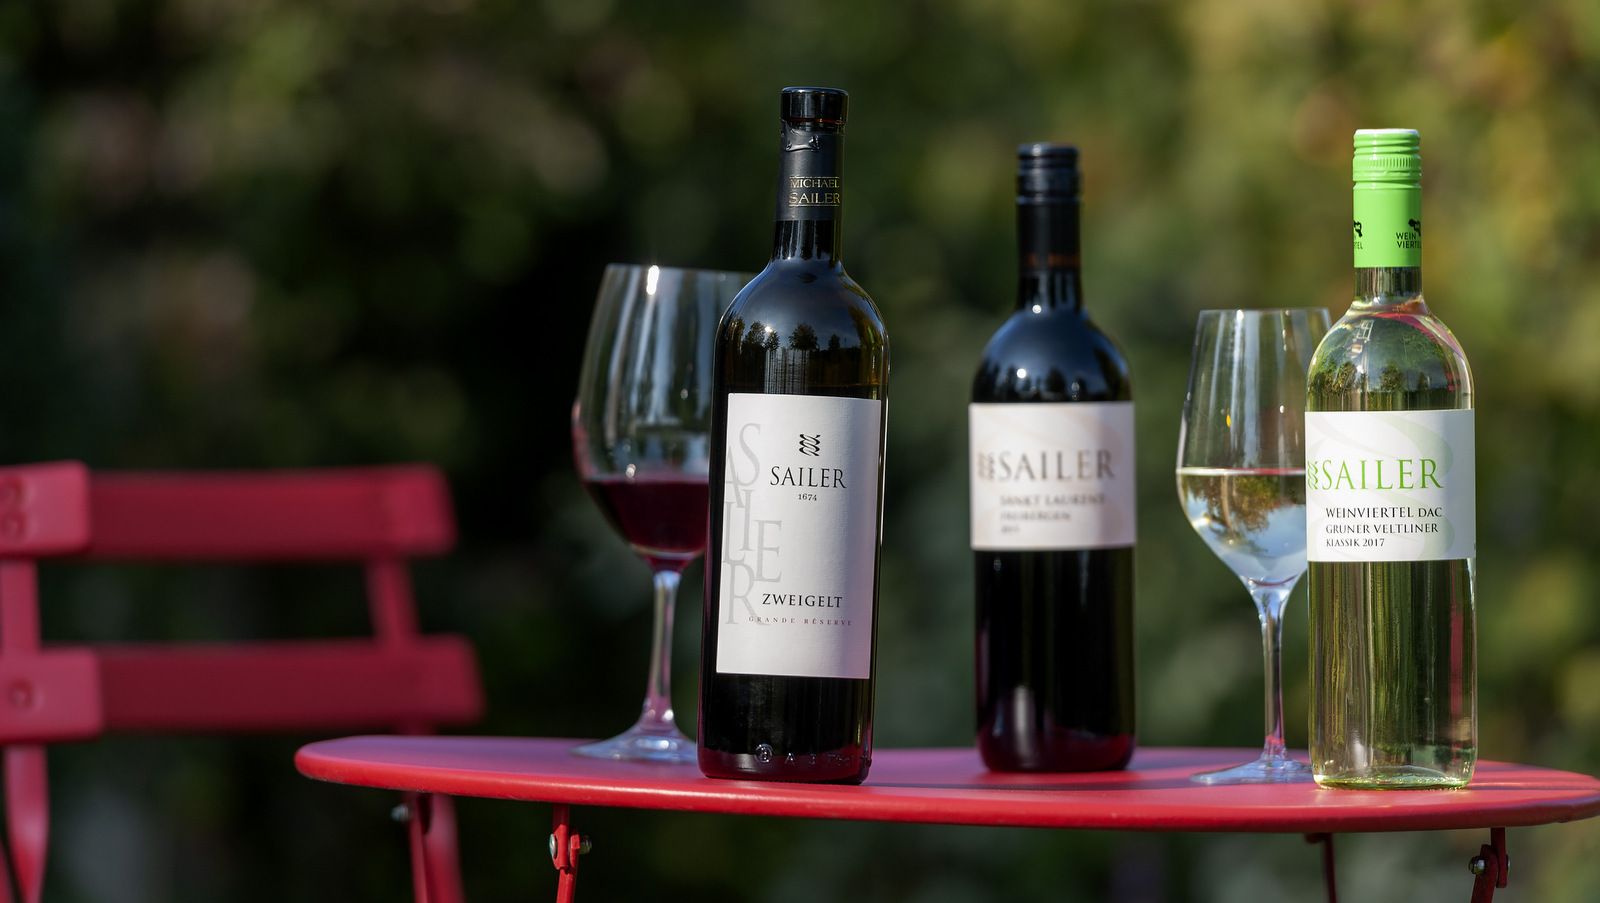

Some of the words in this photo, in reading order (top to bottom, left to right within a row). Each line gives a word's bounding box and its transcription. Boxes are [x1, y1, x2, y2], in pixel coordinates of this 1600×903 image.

[789, 178, 840, 188] MICHAEL
[788, 192, 841, 204] SAILER
[1396, 232, 1417, 240] WEIN
[999, 451, 1116, 481] SAILER
[770, 466, 847, 489] SAILER
[1321, 459, 1445, 490] SAILER
[798, 493, 818, 501] 1674
[1326, 507, 1414, 518] WEINVIERTEL
[1418, 507, 1443, 518] DAC
[1374, 523, 1439, 533] VELTLINER
[1326, 538, 1360, 547] KLASSIK
[1362, 538, 1385, 547] 2017
[762, 593, 843, 608] ZWEIGELT
[748, 616, 797, 624] GRANDE
[803, 617, 853, 626] RÉSERVE
